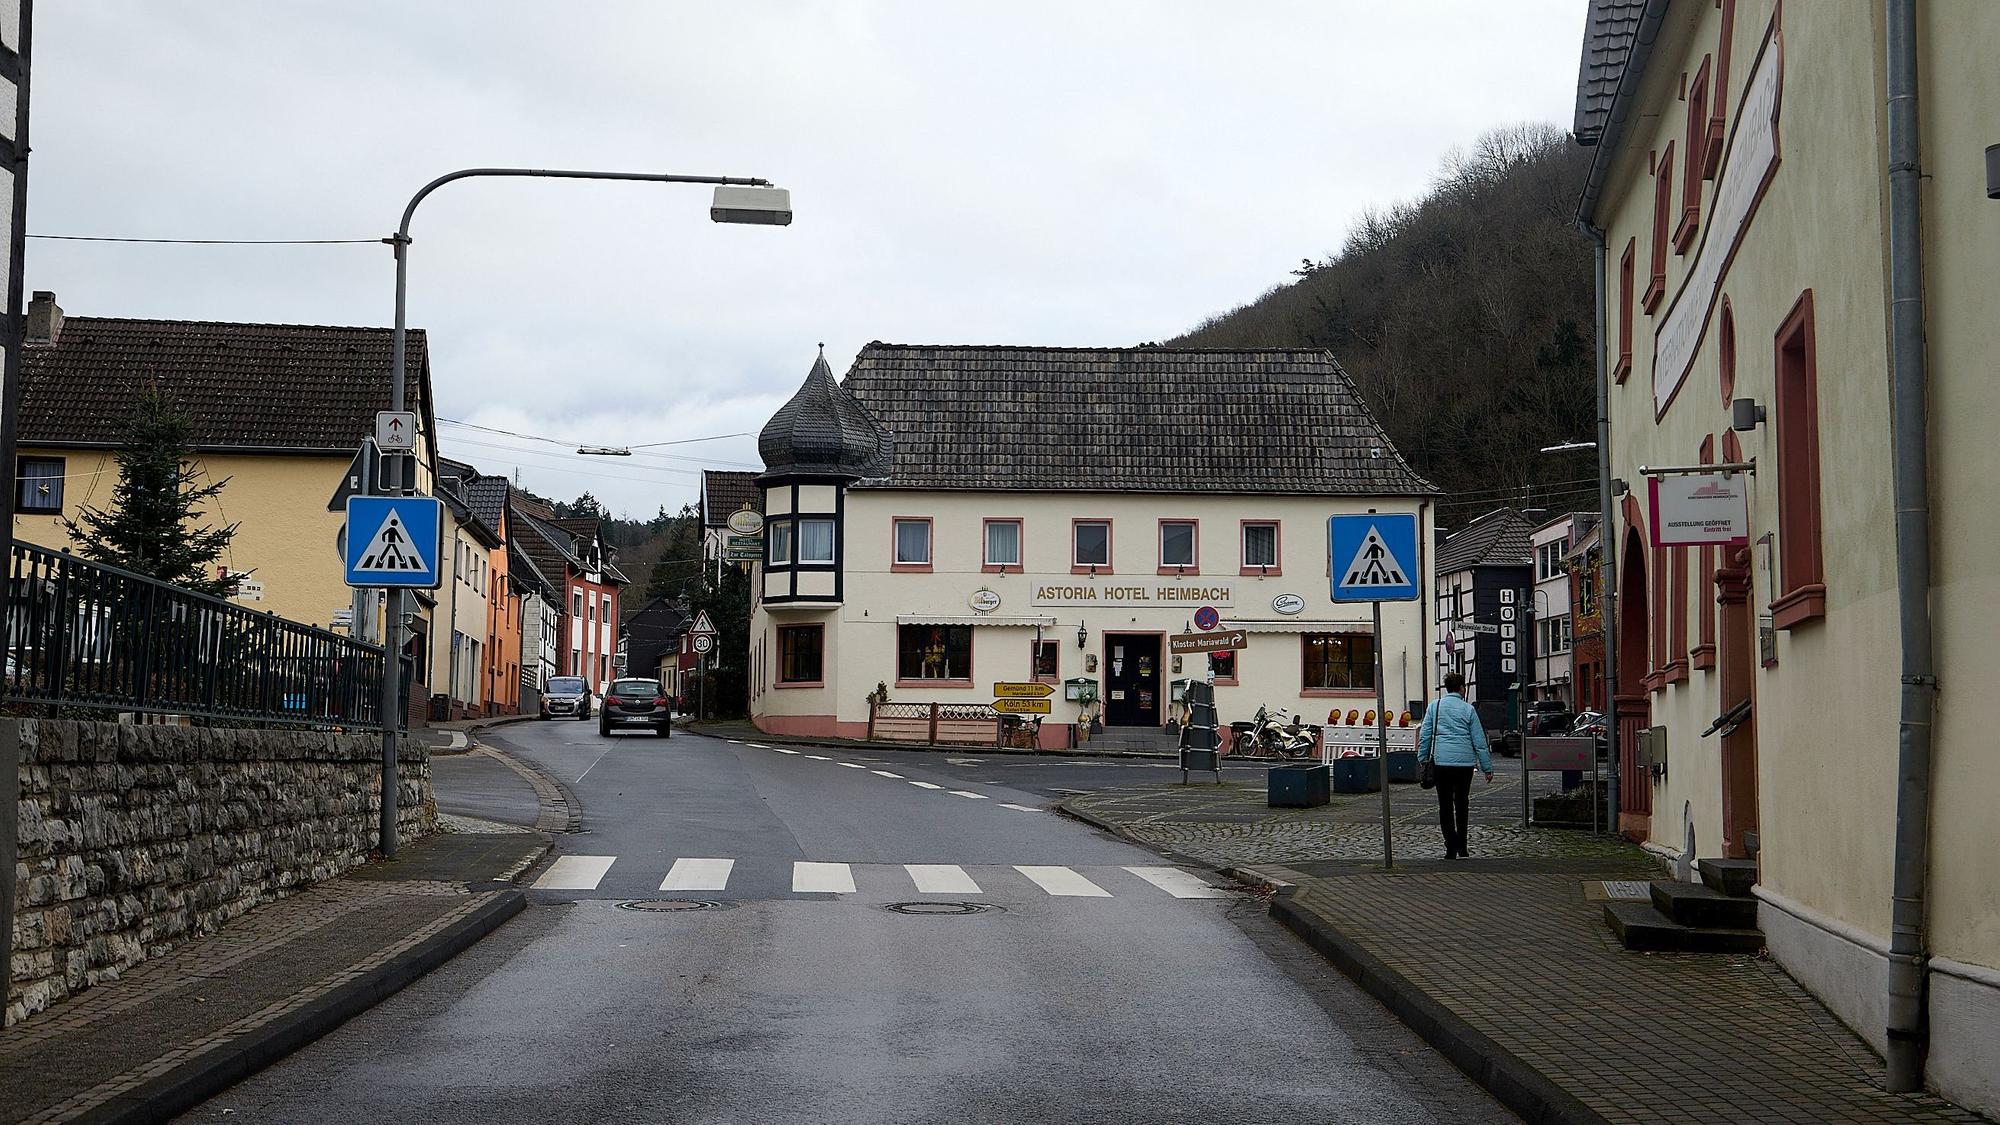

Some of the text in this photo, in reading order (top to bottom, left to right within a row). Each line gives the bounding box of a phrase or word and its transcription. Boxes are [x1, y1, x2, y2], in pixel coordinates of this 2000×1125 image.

[1668, 519, 1731, 528] AUSSTELLUNG GEÖFFNET
[1037, 587, 1229, 601] ASTORIA HOTEL HEIMBACH
[1501, 590, 1514, 672] HOTEL
[697, 639, 708, 648] 30
[1173, 637, 1229, 649] Kloster Mariawald
[1004, 700, 1044, 708] Köln 53 km
